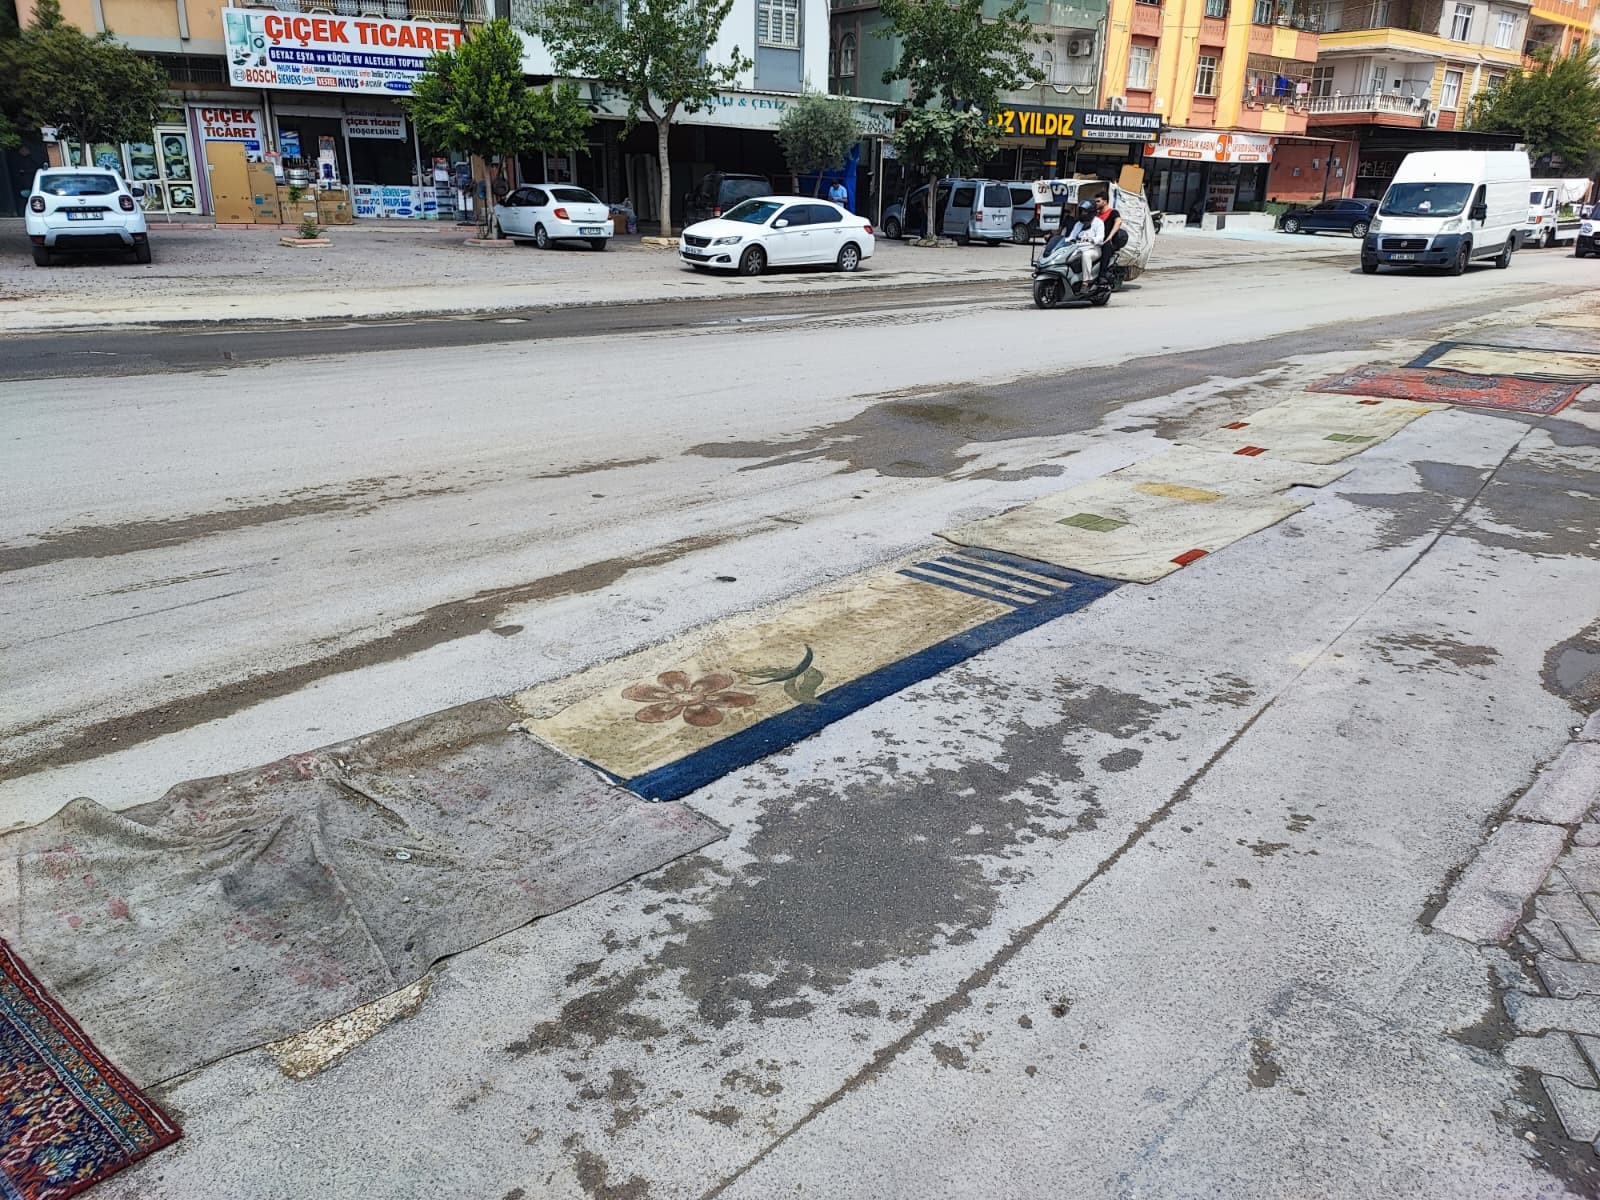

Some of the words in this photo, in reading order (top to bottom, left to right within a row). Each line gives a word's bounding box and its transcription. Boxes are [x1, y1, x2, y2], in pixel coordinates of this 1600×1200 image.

[264, 15, 349, 46] ÇİÇEK
[354, 22, 463, 50] TİCARET
[270, 49, 294, 60] BEYAZ
[296, 51, 314, 63] EŞYA
[316, 54, 326, 62] ve
[327, 52, 351, 66] KÜÇÜK
[353, 55, 362, 64] EV
[365, 55, 396, 67] ALETLERİ
[398, 59, 424, 68] TOPTAN
[245, 69, 277, 84] BOSCH
[277, 74, 302, 85] SIEMENS
[338, 78, 359, 89] ALTUS
[738, 97, 747, 107] &
[202, 108, 255, 126] ÇİÇEK
[1018, 111, 1075, 136] YILDIZ
[1085, 112, 1115, 126] ELEKTRİK
[203, 126, 256, 138] TİCARET
